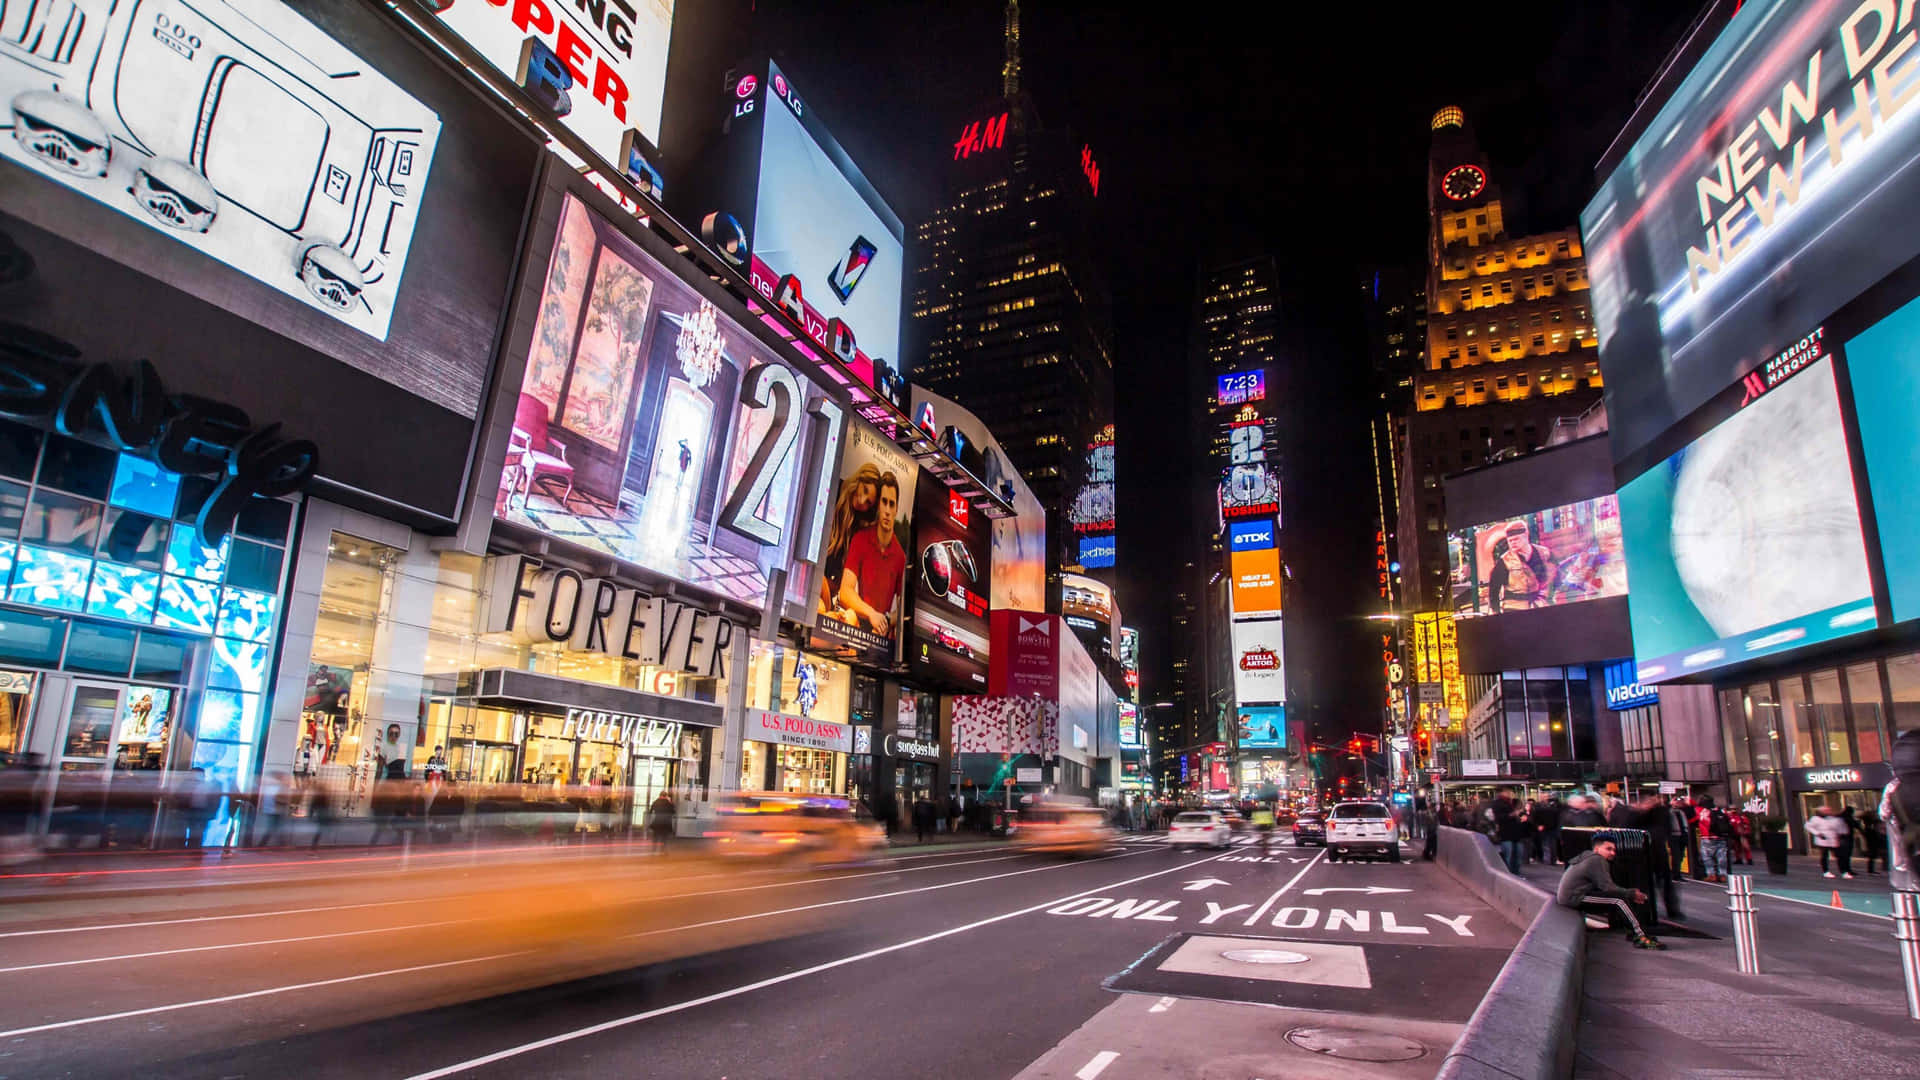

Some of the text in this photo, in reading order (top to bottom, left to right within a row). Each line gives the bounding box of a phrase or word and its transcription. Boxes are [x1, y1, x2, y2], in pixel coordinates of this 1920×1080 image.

[486, 0, 630, 125] PER
[735, 100, 754, 117] LG
[786, 90, 803, 117] LG
[953, 112, 1009, 161] H&M
[1696, 50, 1822, 227] NEW
[1686, 137, 1805, 294] NEW
[1766, 326, 1824, 373] MARRIOTT
[1768, 347, 1820, 385] MARQUIS
[1224, 374, 1258, 391] 7:23
[1234, 411, 1259, 423] 2017
[720, 363, 839, 566] 21
[1223, 502, 1279, 518] TOSHIBA
[1241, 532, 1270, 544] TDK
[502, 554, 733, 680] FOREVER
[822, 618, 839, 630] LIVE
[562, 708, 657, 747] FOREVER
[762, 713, 782, 730] U.S.
[785, 717, 814, 736] POLO
[782, 734, 805, 746] SINCE
[1807, 768, 1851, 784] swatch
[1216, 856, 1310, 864] ONLY
[1046, 897, 1255, 925] ONLY
[1270, 906, 1476, 937] ONLY
